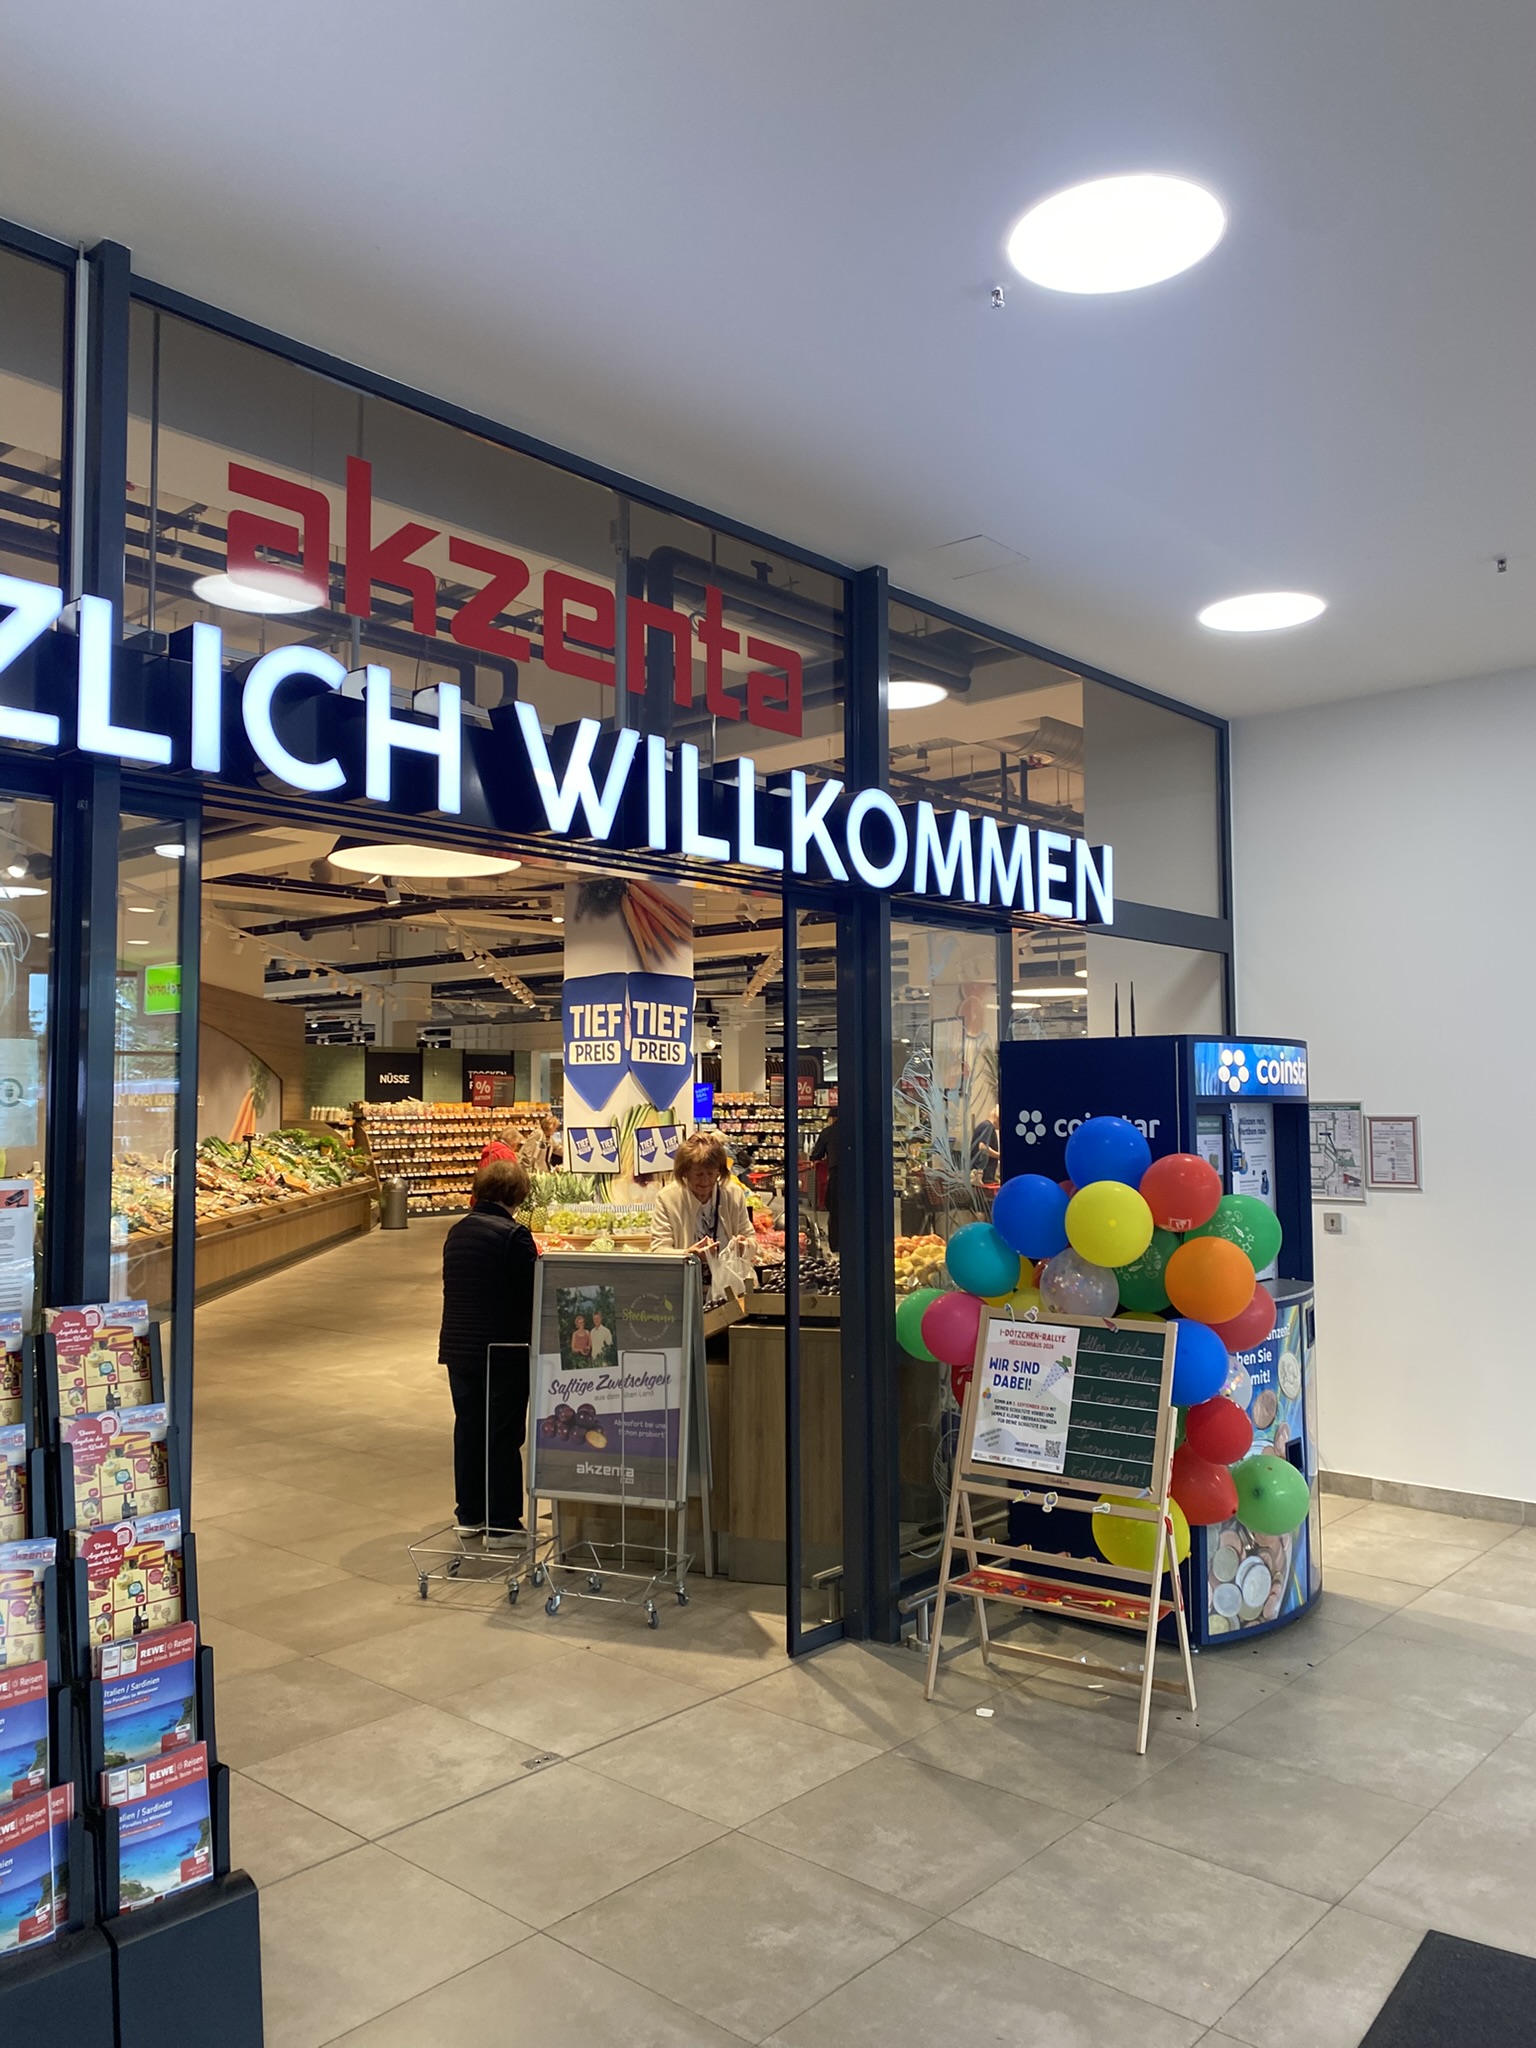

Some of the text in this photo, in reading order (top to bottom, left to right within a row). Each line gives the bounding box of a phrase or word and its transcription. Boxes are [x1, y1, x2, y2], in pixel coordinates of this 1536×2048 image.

[227, 456, 803, 737] akzenta
[514, 701, 1114, 926] WILLKOMMEN
[569, 1003, 623, 1039] TIEF
[632, 1001, 688, 1039] TIEF
[575, 1042, 616, 1063] PREIS
[638, 1041, 681, 1063] PREIS
[379, 1072, 411, 1084] NÜSSE
[1256, 1051, 1307, 1085] coinsta
[1009, 1339, 1042, 1349] HEILIGENHAUS
[1257, 1348, 1272, 1363] Sie
[989, 1357, 1040, 1375] WIR SIND
[548, 1371, 671, 1402] Saftige Zwetschgen
[993, 1374, 1032, 1391] DABEI!
[1250, 1369, 1271, 1386] mit!
[576, 1461, 634, 1478] akzenta
[140, 1637, 192, 1659] REWE Reisen
[20, 1674, 43, 1686] Reisen
[104, 1687, 125, 1698] Italien
[131, 1678, 160, 1691] Sardinien
[149, 1756, 204, 1782] REWE Reisen
[25, 1808, 46, 1823] Reisen
[142, 1800, 173, 1816] Sardinien
